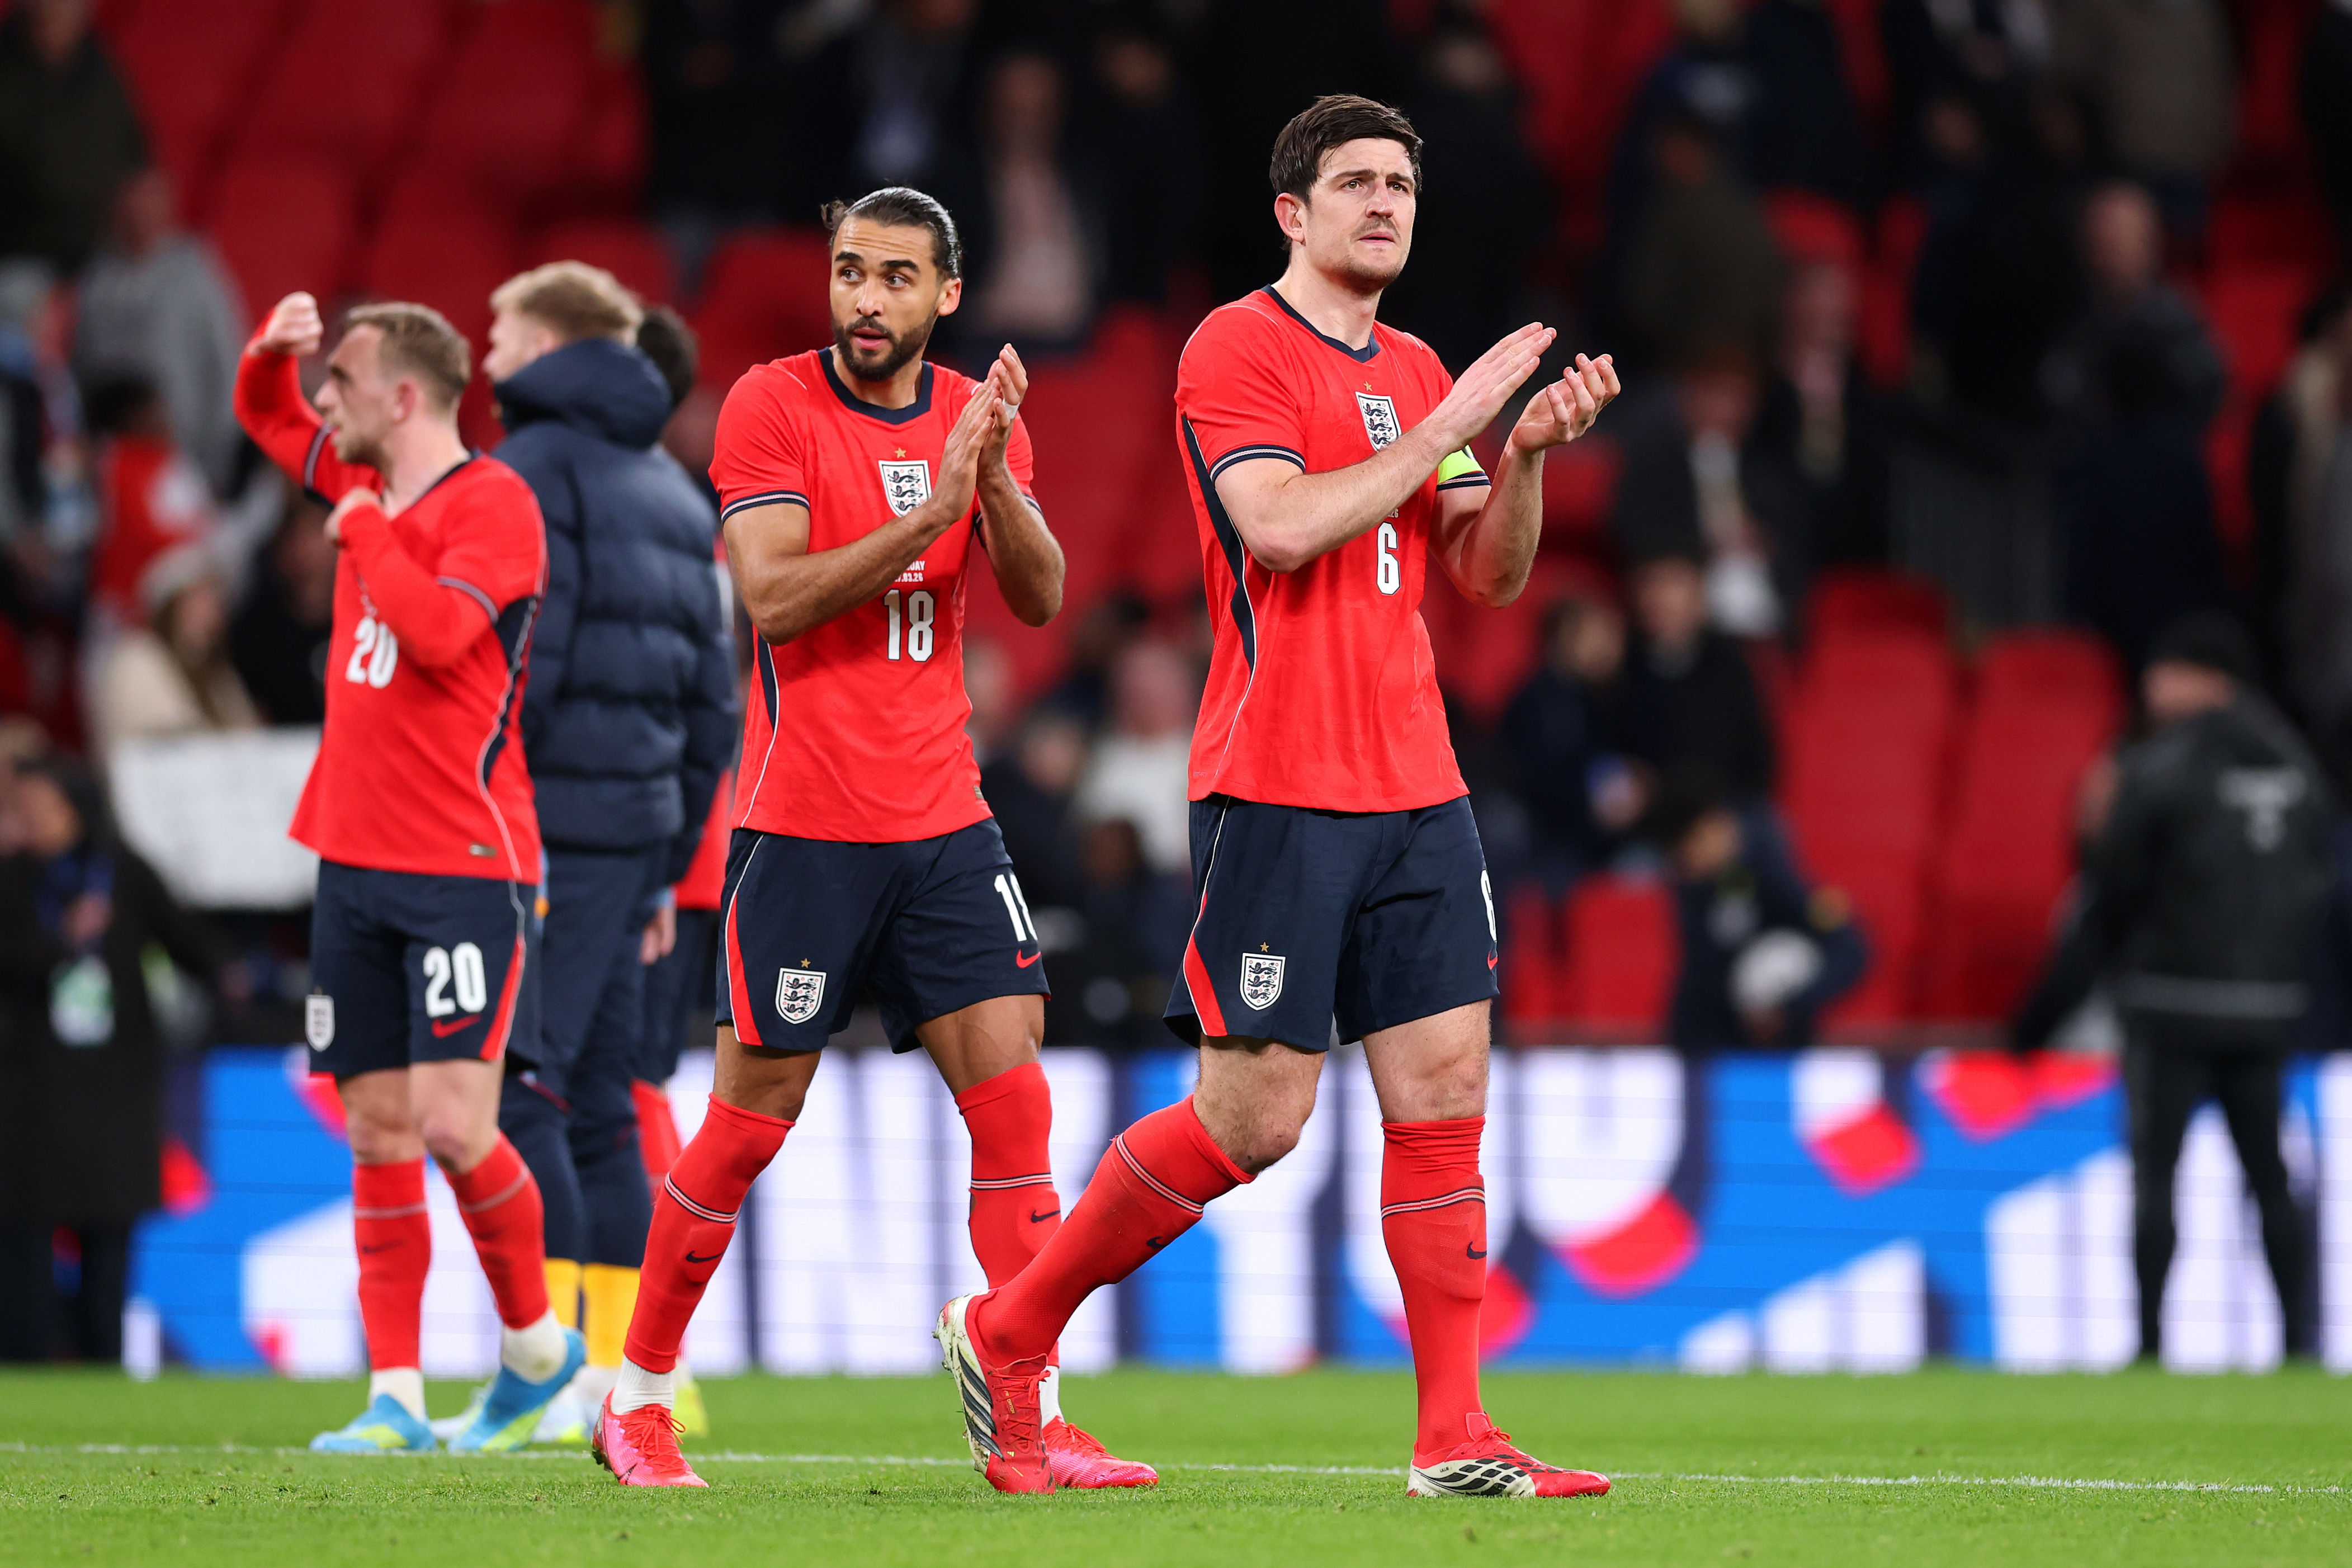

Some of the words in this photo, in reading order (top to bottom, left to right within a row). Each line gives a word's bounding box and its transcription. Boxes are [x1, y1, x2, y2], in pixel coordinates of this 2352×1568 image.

[1377, 521, 1401, 596] 6
[346, 616, 398, 689] 20
[884, 589, 934, 662] 18
[423, 941, 487, 1018] 20
